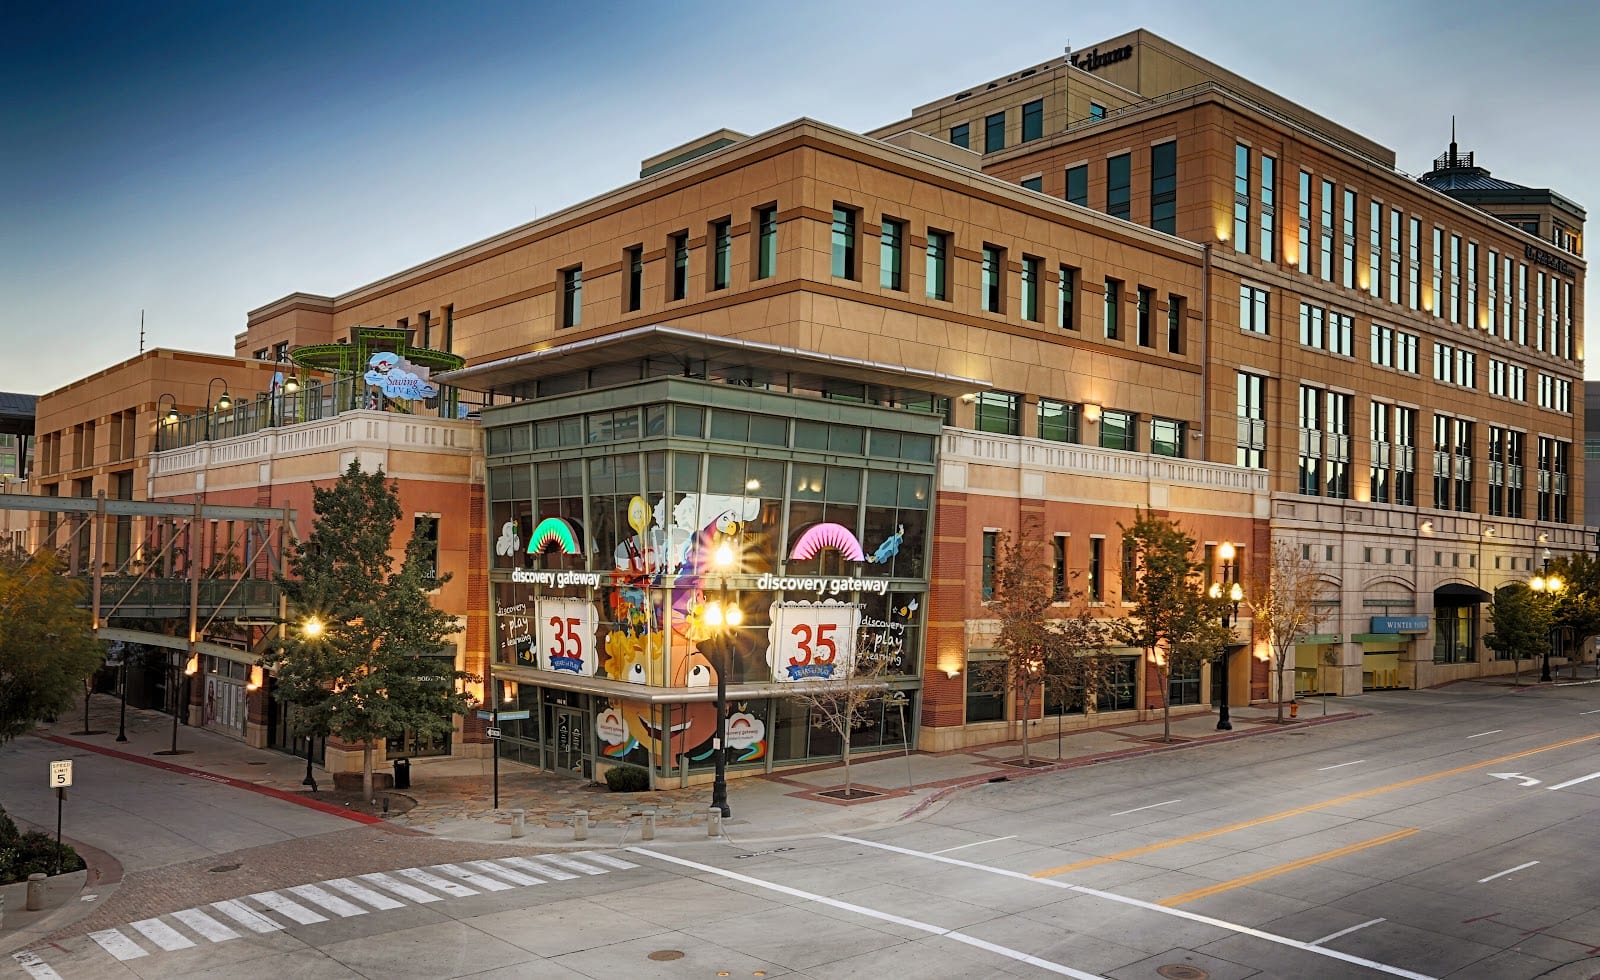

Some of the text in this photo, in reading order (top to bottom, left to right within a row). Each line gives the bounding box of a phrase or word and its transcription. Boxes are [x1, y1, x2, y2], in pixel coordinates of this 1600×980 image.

[386, 386, 419, 395] LIVES
[387, 375, 418, 389] Saving
[511, 567, 600, 590] discovery gateway
[757, 573, 889, 595] discovery gateway
[498, 602, 526, 616] discovery
[509, 615, 529, 638] play
[861, 615, 905, 635] discovery
[549, 616, 582, 659] 35
[788, 623, 838, 666] 35
[874, 631, 903, 655] play
[57, 774, 66, 784] 5
